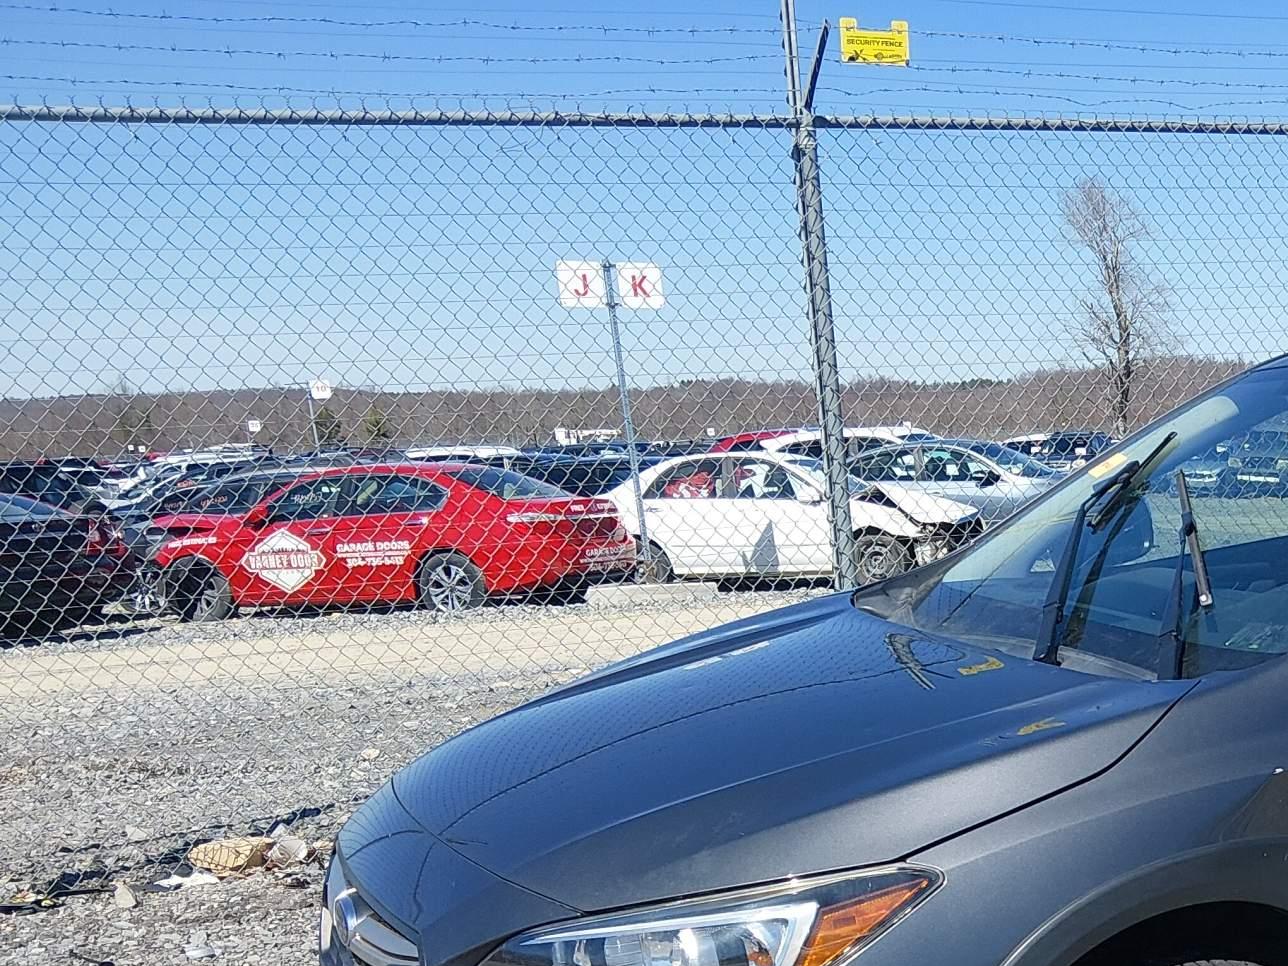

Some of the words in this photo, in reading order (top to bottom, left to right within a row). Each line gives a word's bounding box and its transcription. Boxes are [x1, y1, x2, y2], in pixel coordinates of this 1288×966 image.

[881, 40, 904, 48] FENCE
[573, 273, 589, 297] J
[631, 274, 651, 298] K
[336, 542, 375, 553] GARAGE
[376, 541, 410, 551] DOORS
